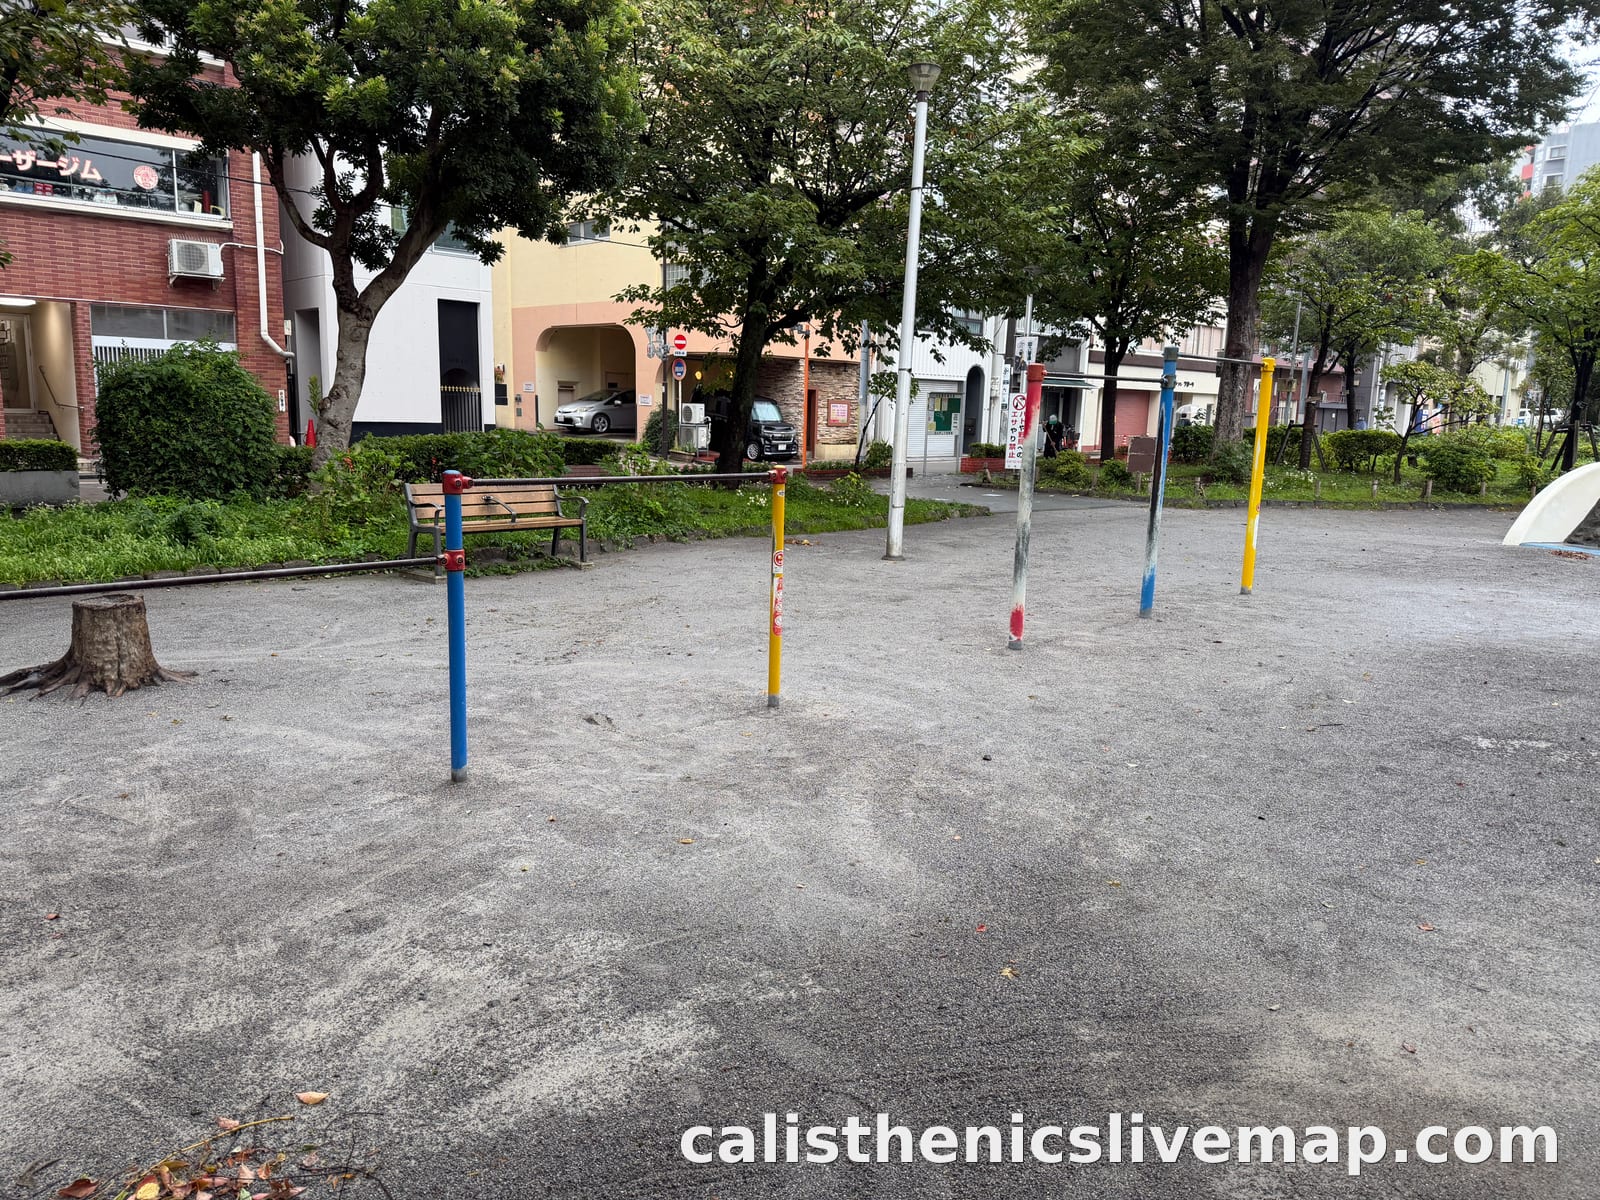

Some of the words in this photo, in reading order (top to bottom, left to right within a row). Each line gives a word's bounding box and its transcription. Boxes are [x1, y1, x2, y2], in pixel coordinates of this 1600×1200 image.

[1008, 411, 1018, 458] エサやり禁止
